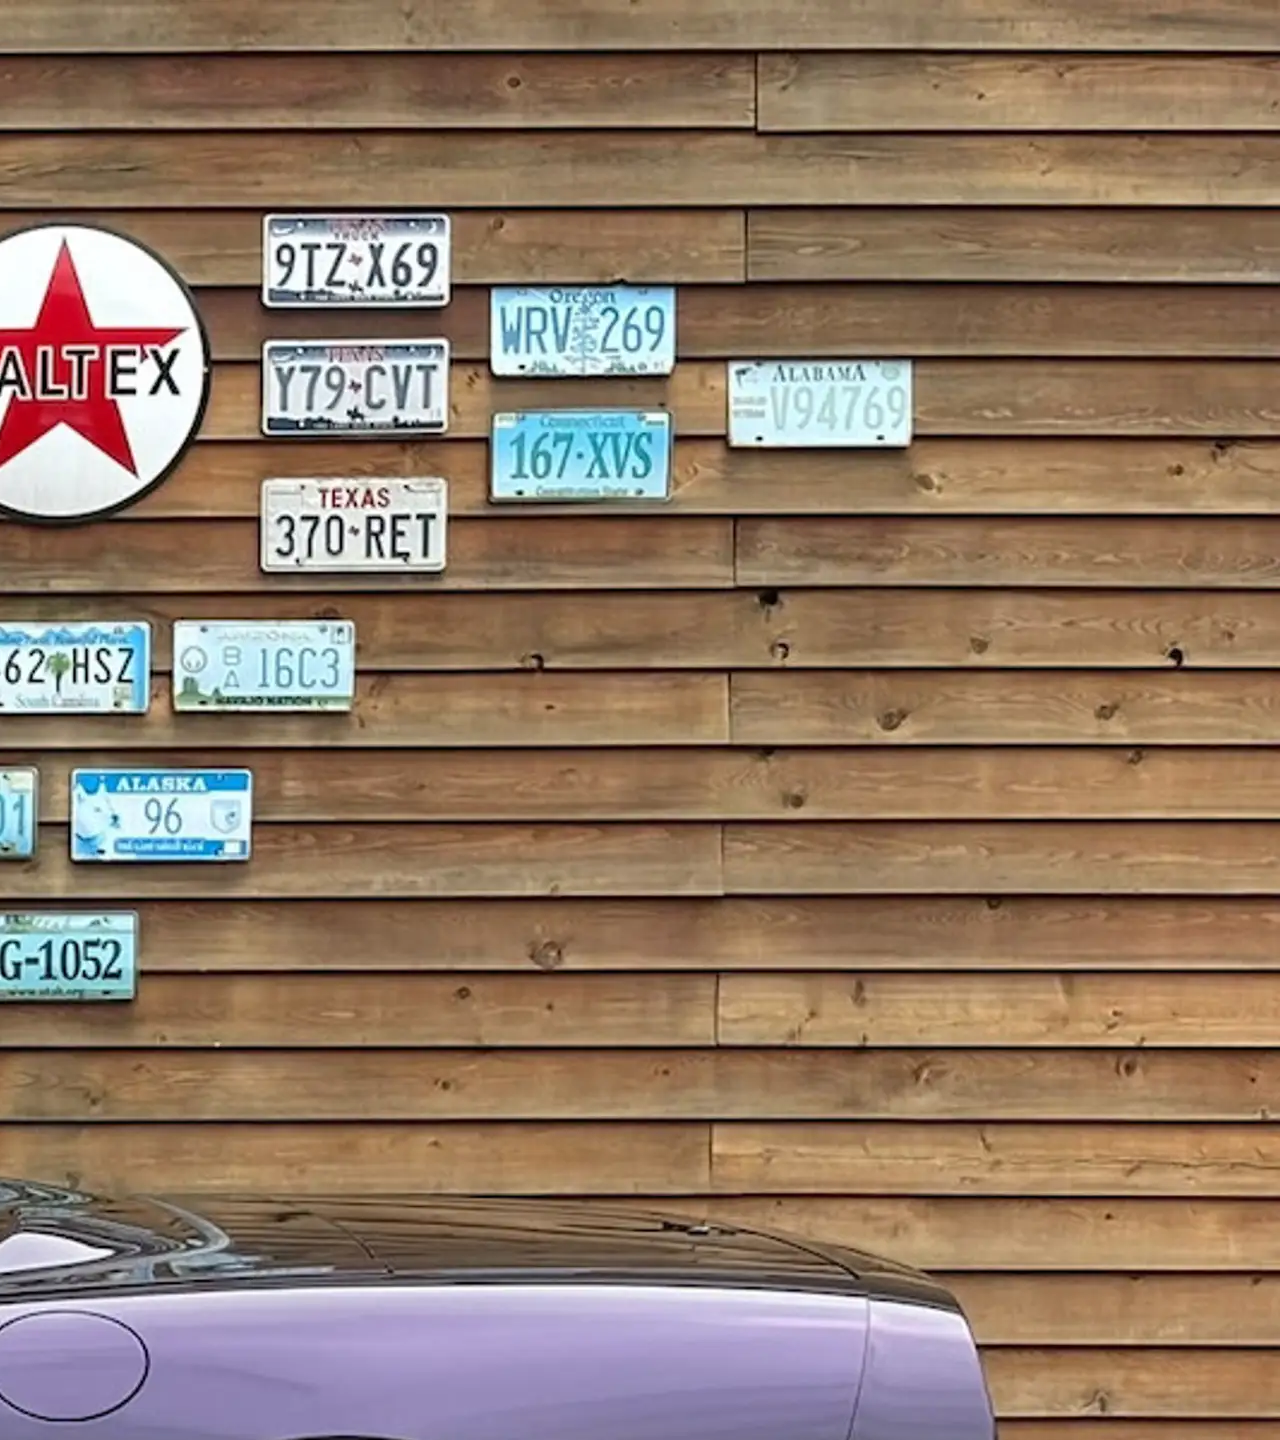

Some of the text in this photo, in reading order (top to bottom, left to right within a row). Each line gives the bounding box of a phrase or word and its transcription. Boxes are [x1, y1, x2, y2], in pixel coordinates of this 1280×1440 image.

[549, 288, 617, 305] Oregon
[500, 305, 666, 355] WRV 269
[772, 364, 867, 383] ALABAMA
[769, 385, 906, 431] V94769
[317, 487, 391, 509] TEXAS
[71, 647, 136, 685] HSZ
[115, 776, 209, 793] ALASKA
[144, 797, 183, 836] 96
